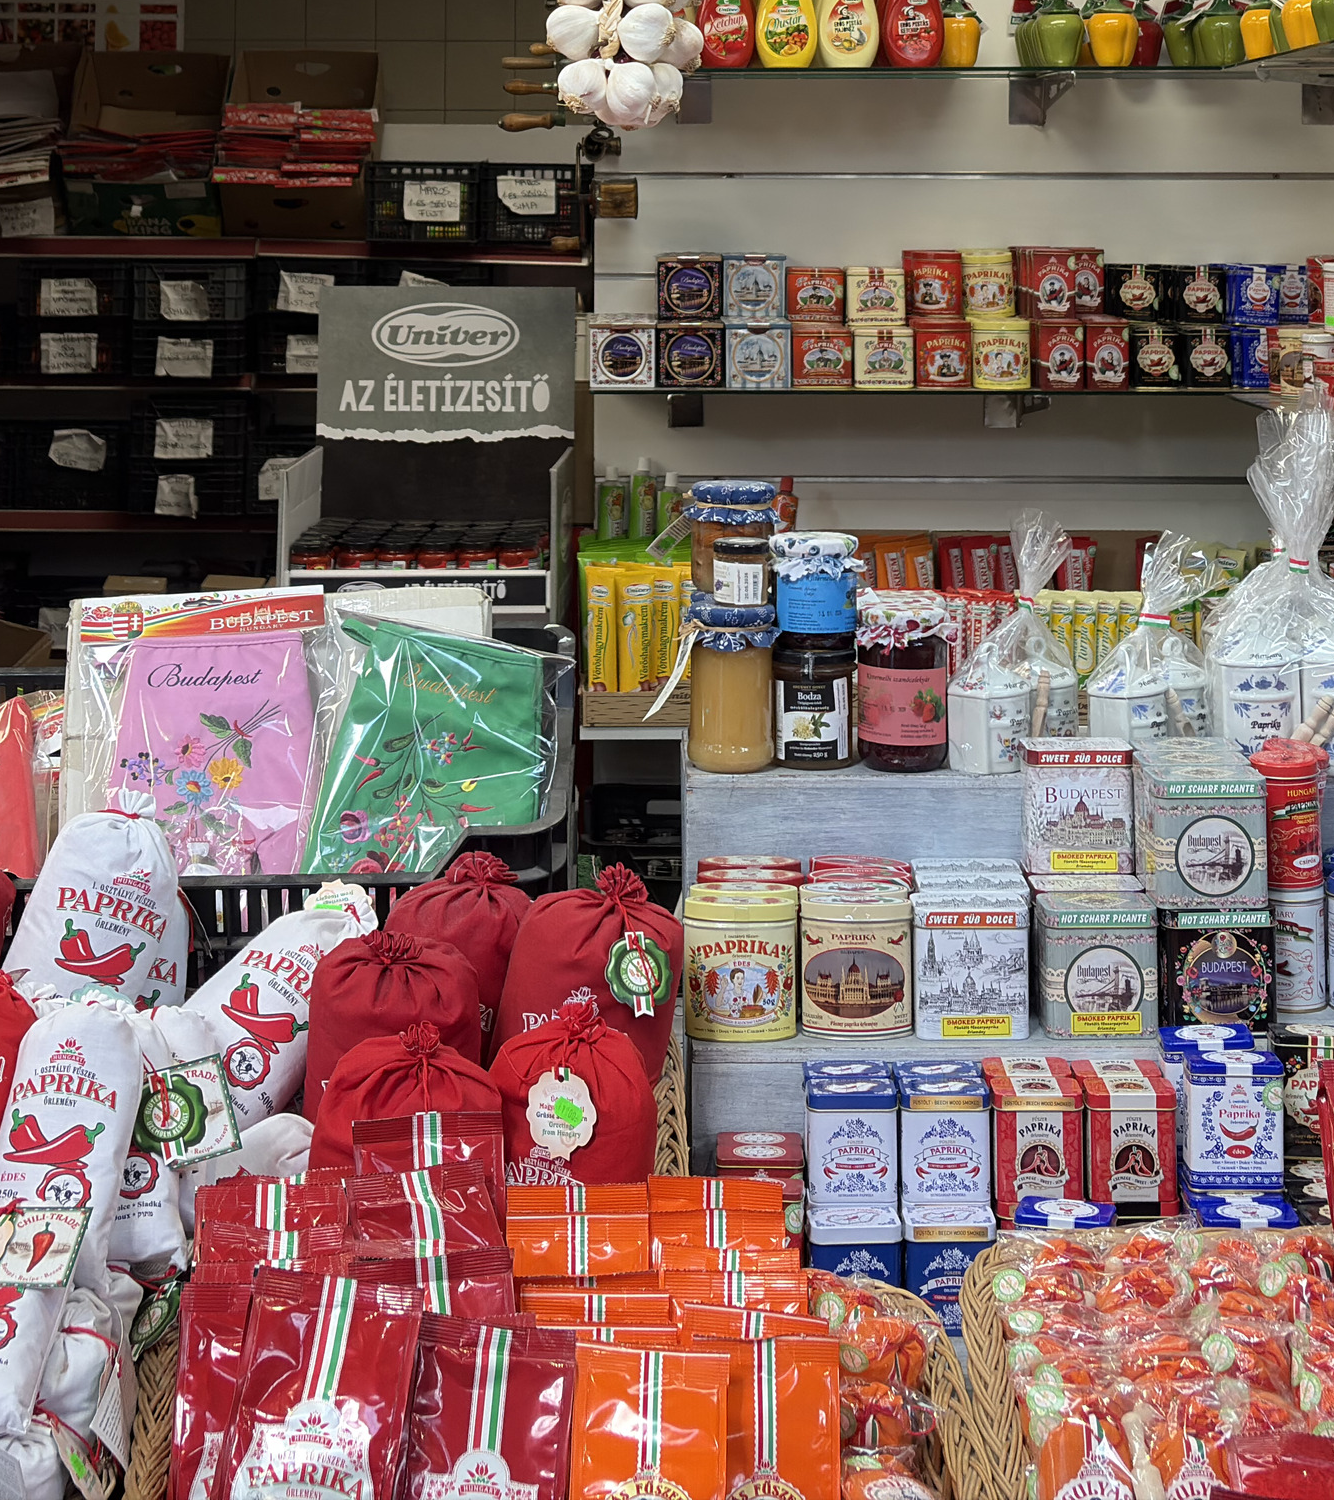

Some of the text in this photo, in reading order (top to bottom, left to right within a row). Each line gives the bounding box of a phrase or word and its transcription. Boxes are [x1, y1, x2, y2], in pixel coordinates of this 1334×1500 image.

[710, 14, 744, 33] Ketchup
[913, 266, 949, 279] PAPRIKA
[966, 270, 1007, 281] PAPRIKA
[387, 324, 509, 346] Univer
[926, 338, 966, 350] PAPRIKA
[980, 338, 1022, 349] PAPRIKA
[339, 372, 551, 413] AZ ÉLETÍZESÍTŐ
[210, 608, 314, 632] BUDAPEST
[593, 607, 604, 681] Vöröshagymakrém
[639, 605, 650, 680] Vöröshagymakrém
[656, 602, 668, 676] Vöröshagymakrém
[147, 662, 262, 690] Budapest
[399, 661, 496, 707] Budapest
[797, 691, 822, 701] Bodza
[1250, 719, 1281, 731] Paprika
[1040, 753, 1123, 765] SWEET DOLCE
[1045, 787, 1123, 803] BUDAPEST
[1170, 783, 1255, 794] HOT SCHARF PICANTE
[1187, 834, 1222, 849] Budapest
[1055, 852, 1081, 860] SMOKED
[57, 886, 168, 943] PAPRIKA
[928, 914, 1014, 925] SWEET DOLCE
[1060, 913, 1147, 924] HOT SCHARF PICANTE
[1180, 913, 1267, 926] HOT SCHARF PICANTE
[701, 940, 780, 959] PAPRIKA
[733, 959, 751, 967] ÉDES
[1201, 961, 1247, 974] BUDAPEST
[1076, 965, 1111, 980] Budapest
[1076, 1014, 1103, 1022] SMOKED
[183, 1069, 219, 1084] TRADE
[12, 1077, 117, 1112] PAPRIKA
[43, 1096, 78, 1108] ŐRLEMÉNY
[1218, 1107, 1261, 1120] Paprika
[1019, 1126, 1062, 1139] PAPRIKA
[1113, 1125, 1155, 1138] PAPRIKA
[837, 1148, 876, 1158] PAPRIKA
[930, 1147, 968, 1157] PAPRIKA
[0, 1171, 27, 1183] ÉDES
[17, 1211, 80, 1230] CHILI-TRADE
